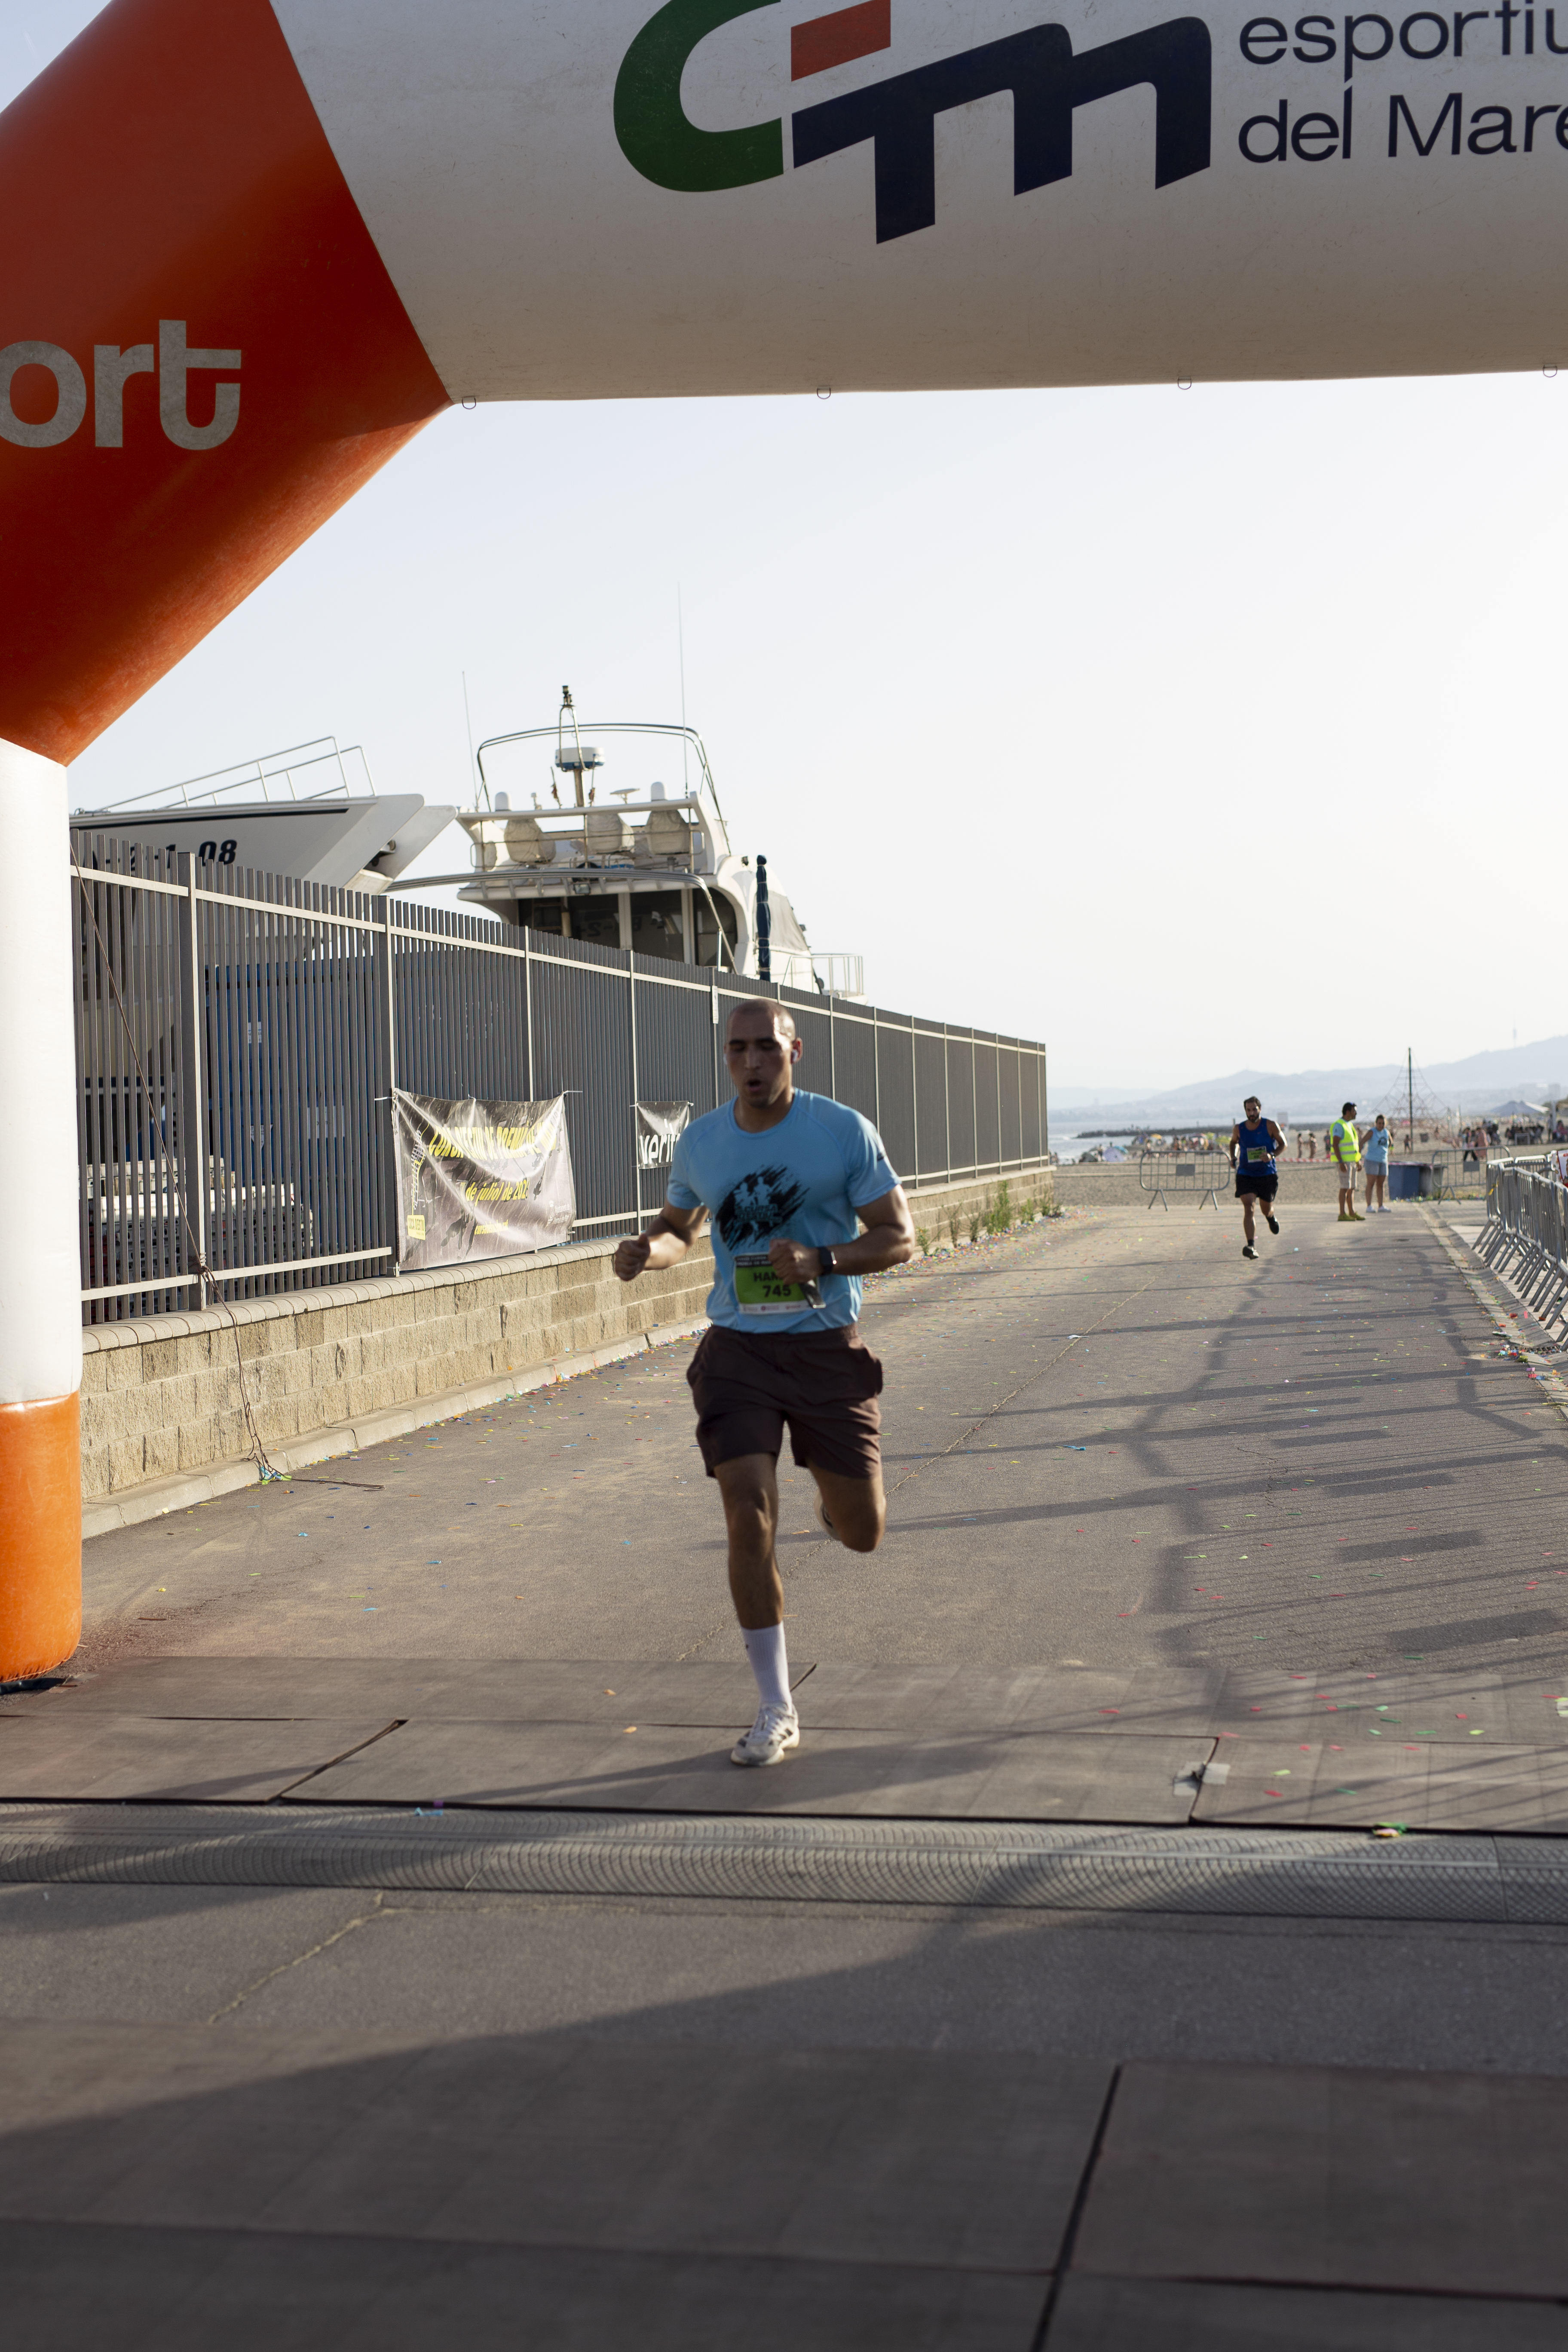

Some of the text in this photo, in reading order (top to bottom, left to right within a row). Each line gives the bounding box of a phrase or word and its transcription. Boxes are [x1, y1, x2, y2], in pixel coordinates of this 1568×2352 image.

[1238, 85, 1568, 163] del Mar
[0, 319, 242, 450] ort
[640, 1118, 680, 1164] verit
[466, 1182, 477, 1201] de
[475, 1182, 504, 1207] juliol
[501, 1181, 513, 1201] de
[763, 1284, 791, 1297] 745
